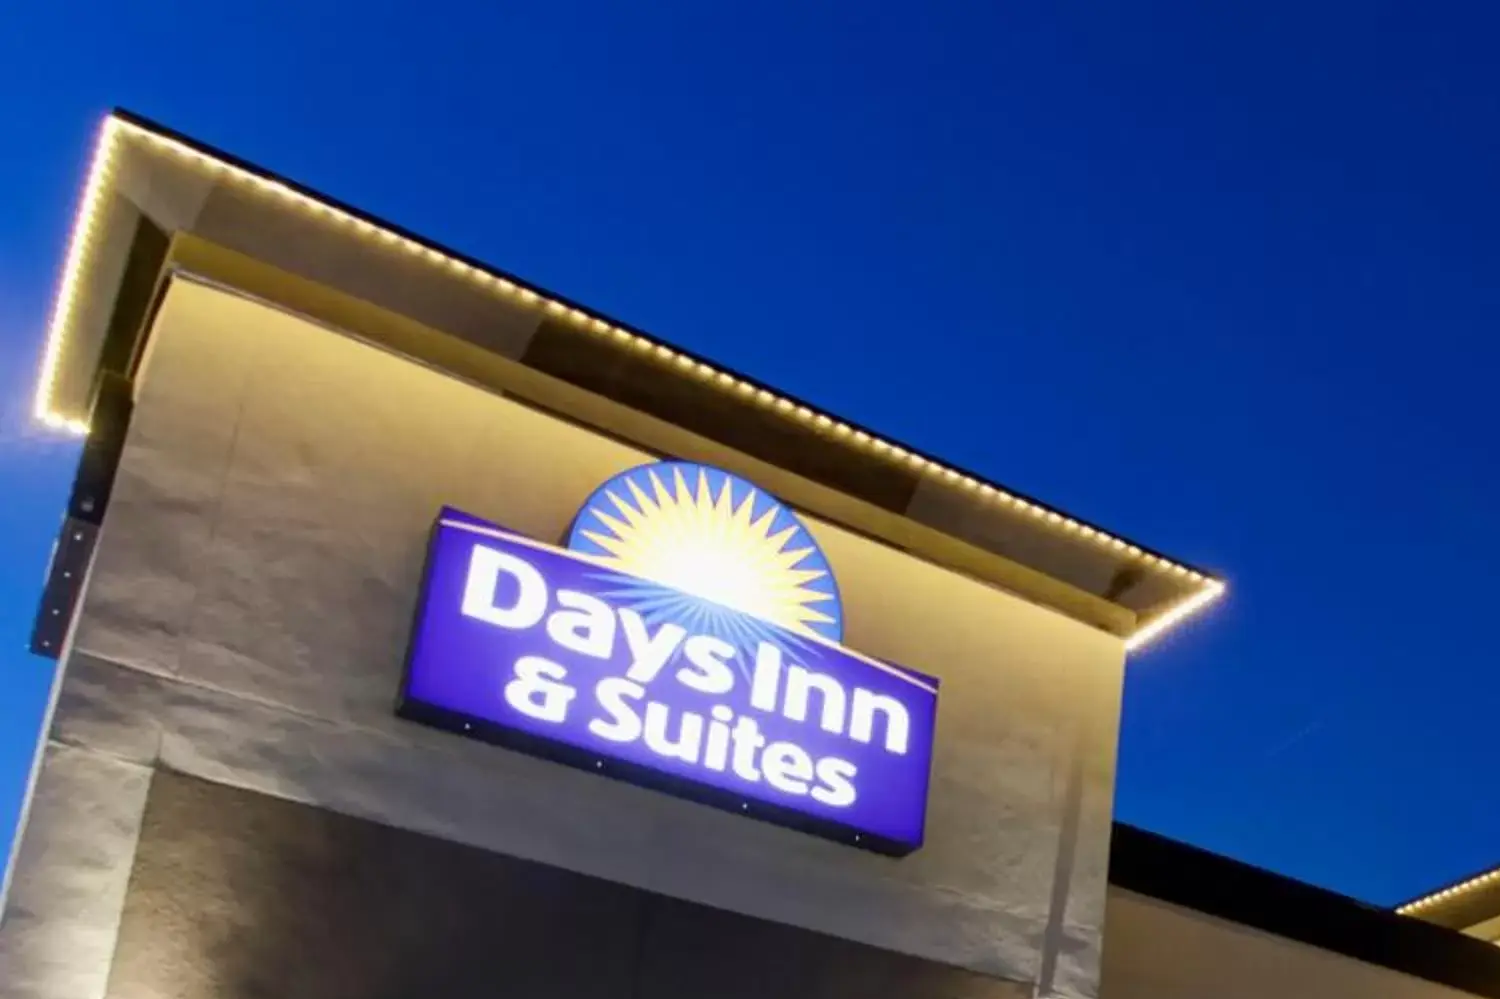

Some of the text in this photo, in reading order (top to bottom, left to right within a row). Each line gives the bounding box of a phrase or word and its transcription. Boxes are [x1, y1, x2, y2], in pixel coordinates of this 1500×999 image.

[461, 544, 909, 755] Days Inn
[504, 656, 857, 807] & Suites
